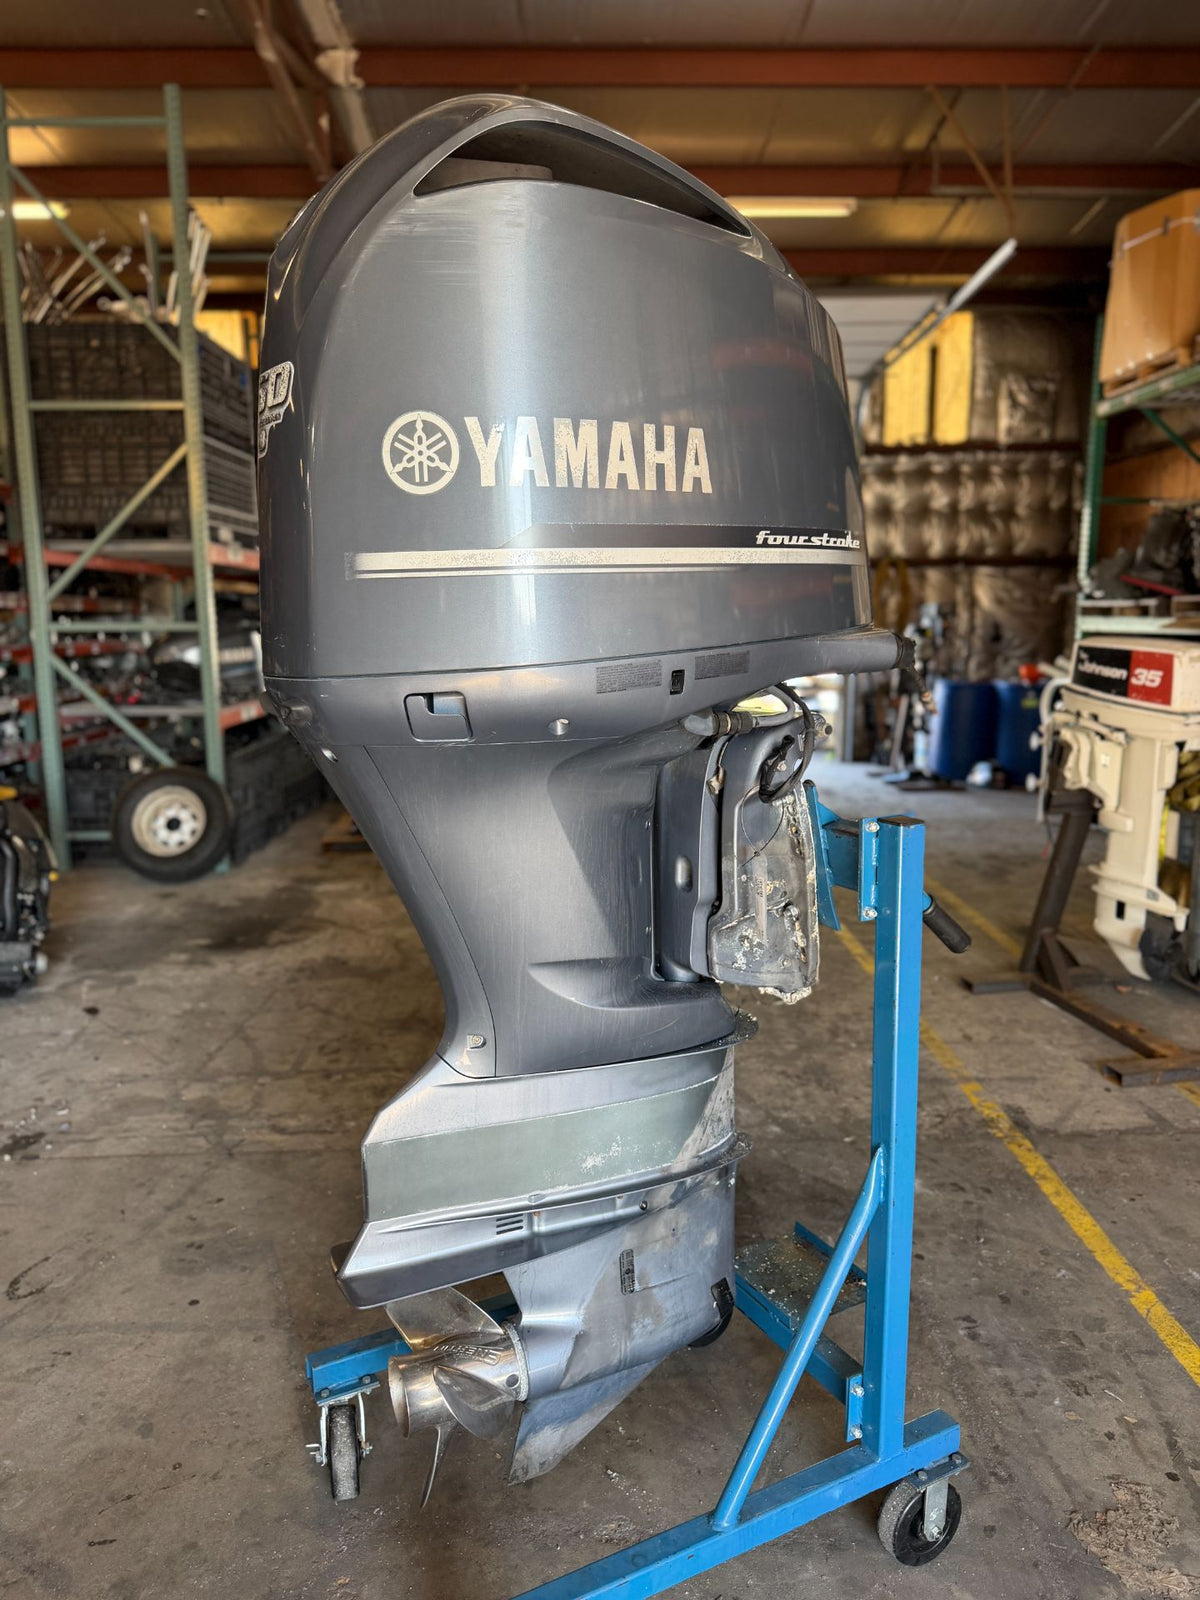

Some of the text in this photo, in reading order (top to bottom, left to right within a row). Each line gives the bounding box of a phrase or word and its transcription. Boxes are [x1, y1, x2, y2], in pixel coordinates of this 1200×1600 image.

[464, 416, 712, 494] YAMAHA
[1078, 660, 1164, 688] Johnson 35
